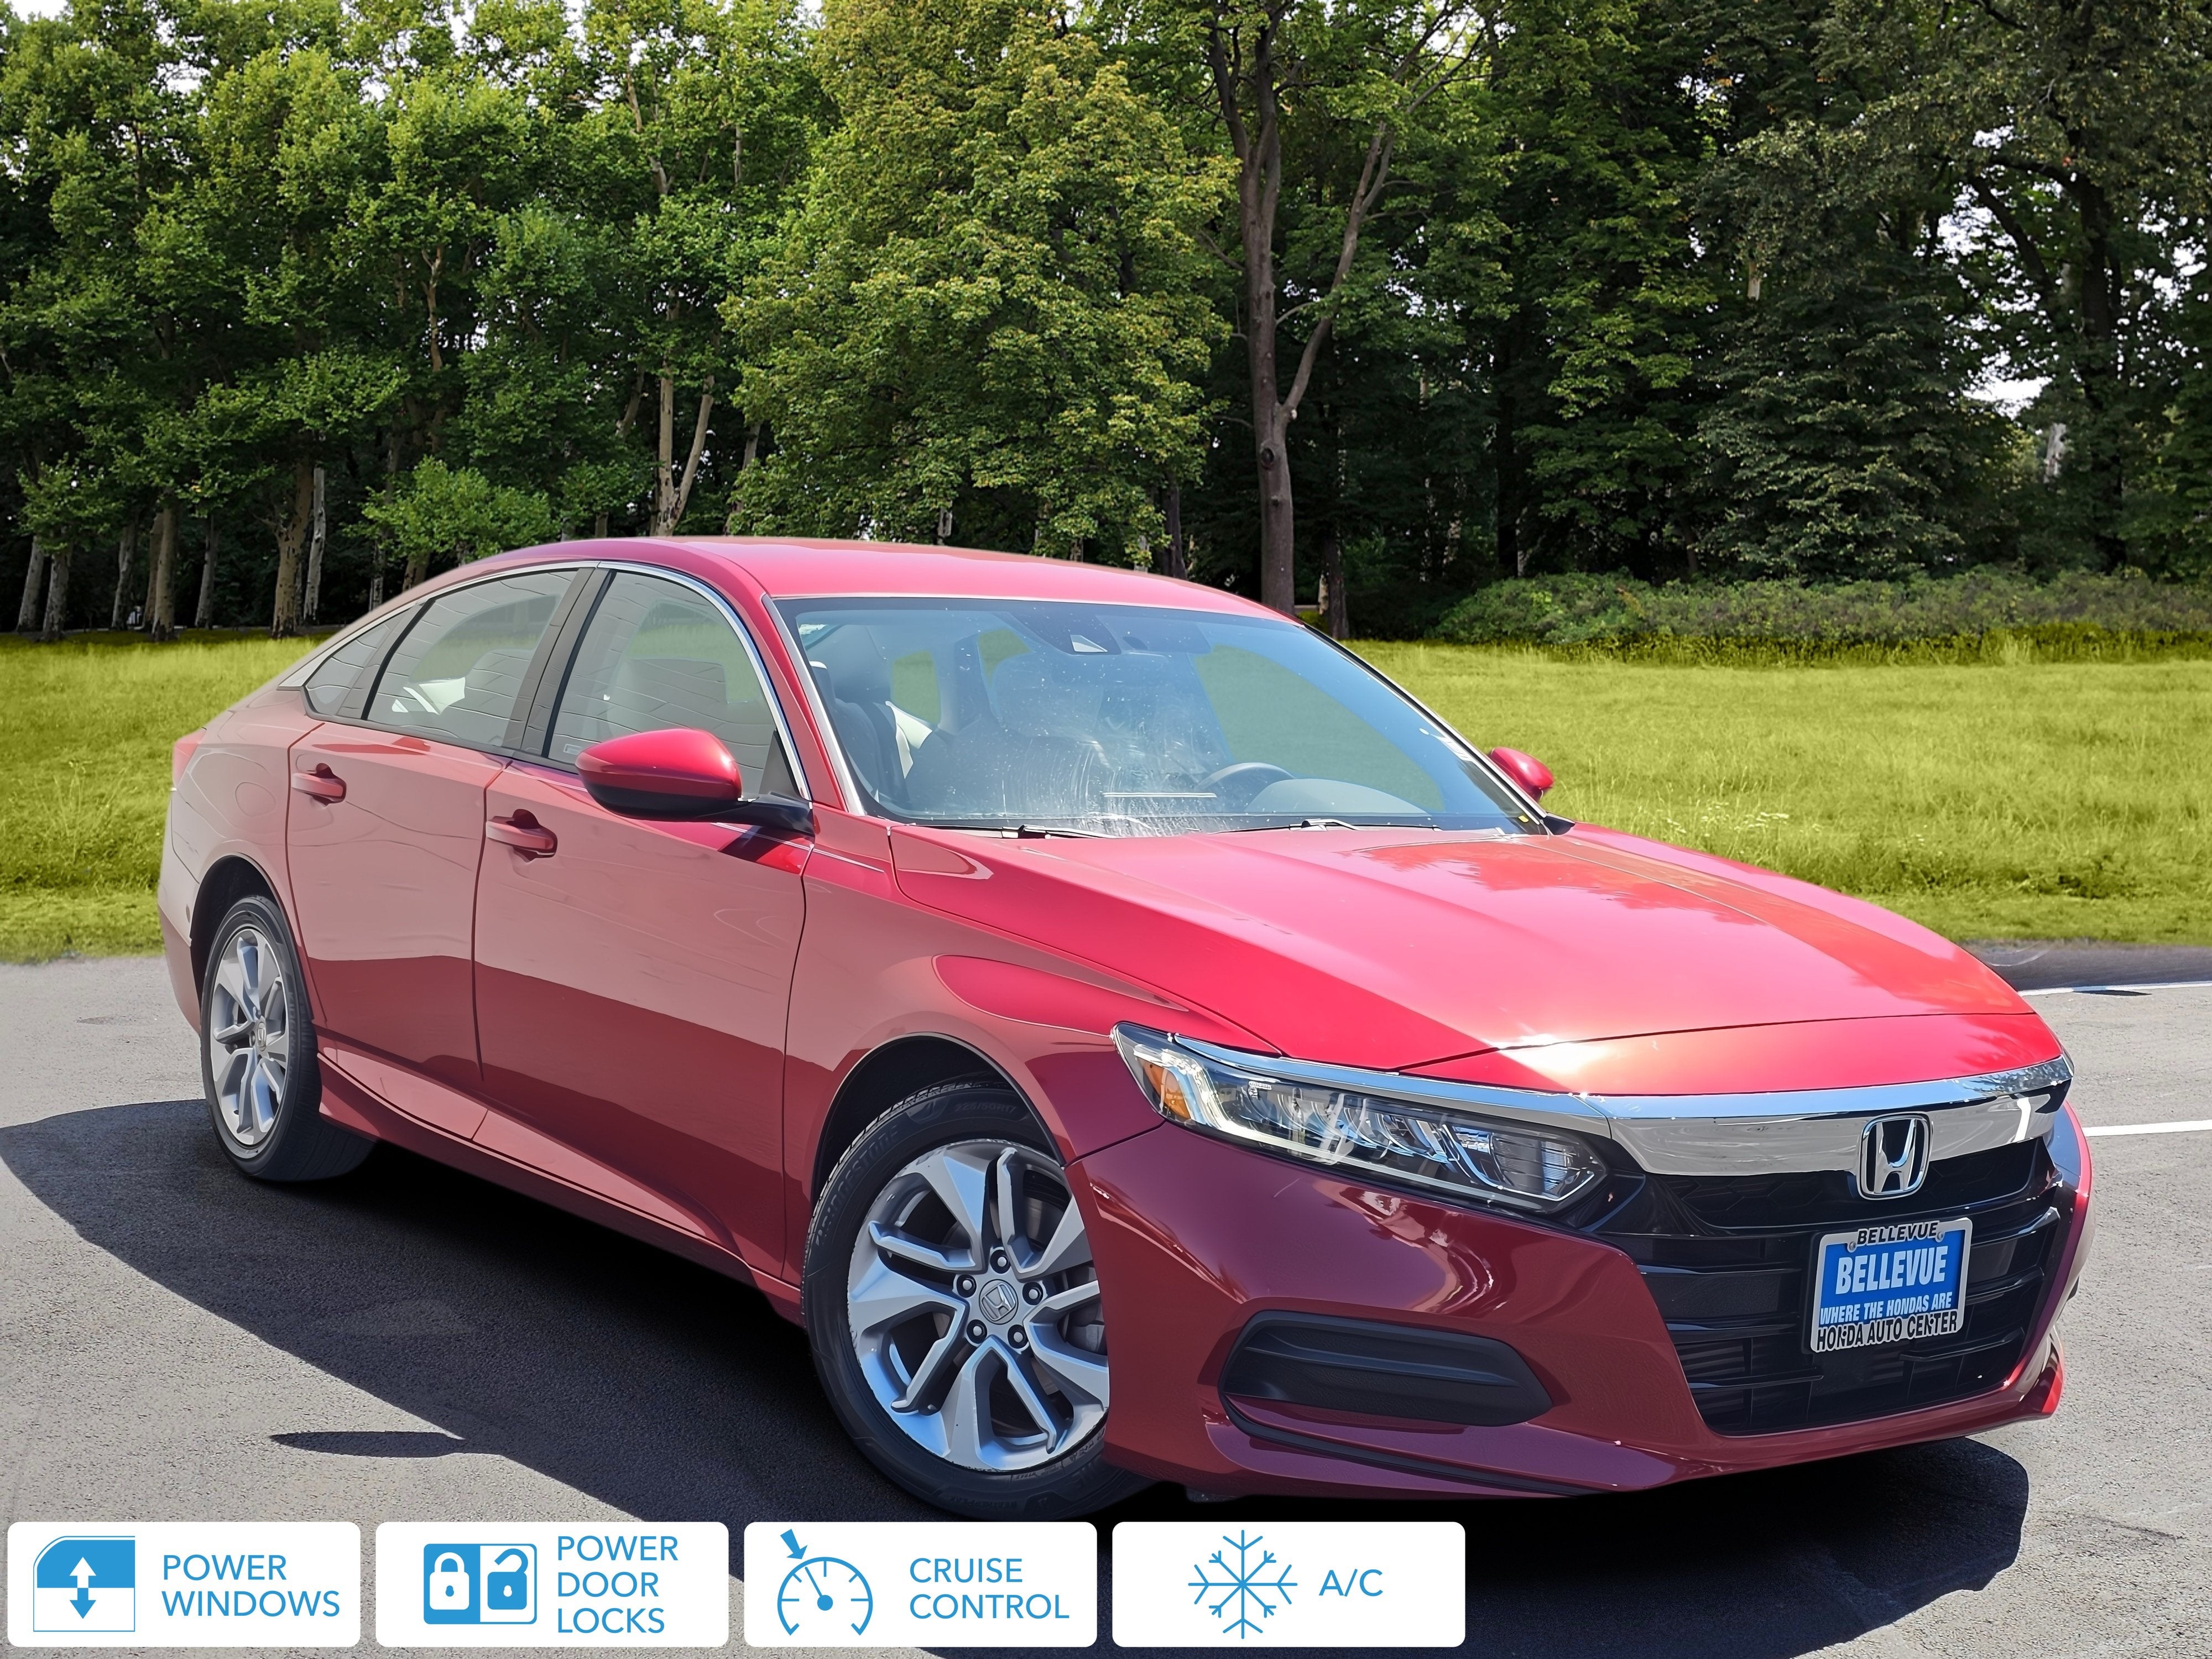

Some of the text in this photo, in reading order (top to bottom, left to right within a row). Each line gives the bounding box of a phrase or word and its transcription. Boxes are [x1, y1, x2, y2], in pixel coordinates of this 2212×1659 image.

[1857, 1222, 1939, 1245] BELLEVUE
[1835, 1246, 1948, 1295] BELLEVUE
[1820, 1292, 1953, 1325] WHERE THE HONDAS ARE
[1817, 1311, 1958, 1350] HONDA AUTO CENTER
